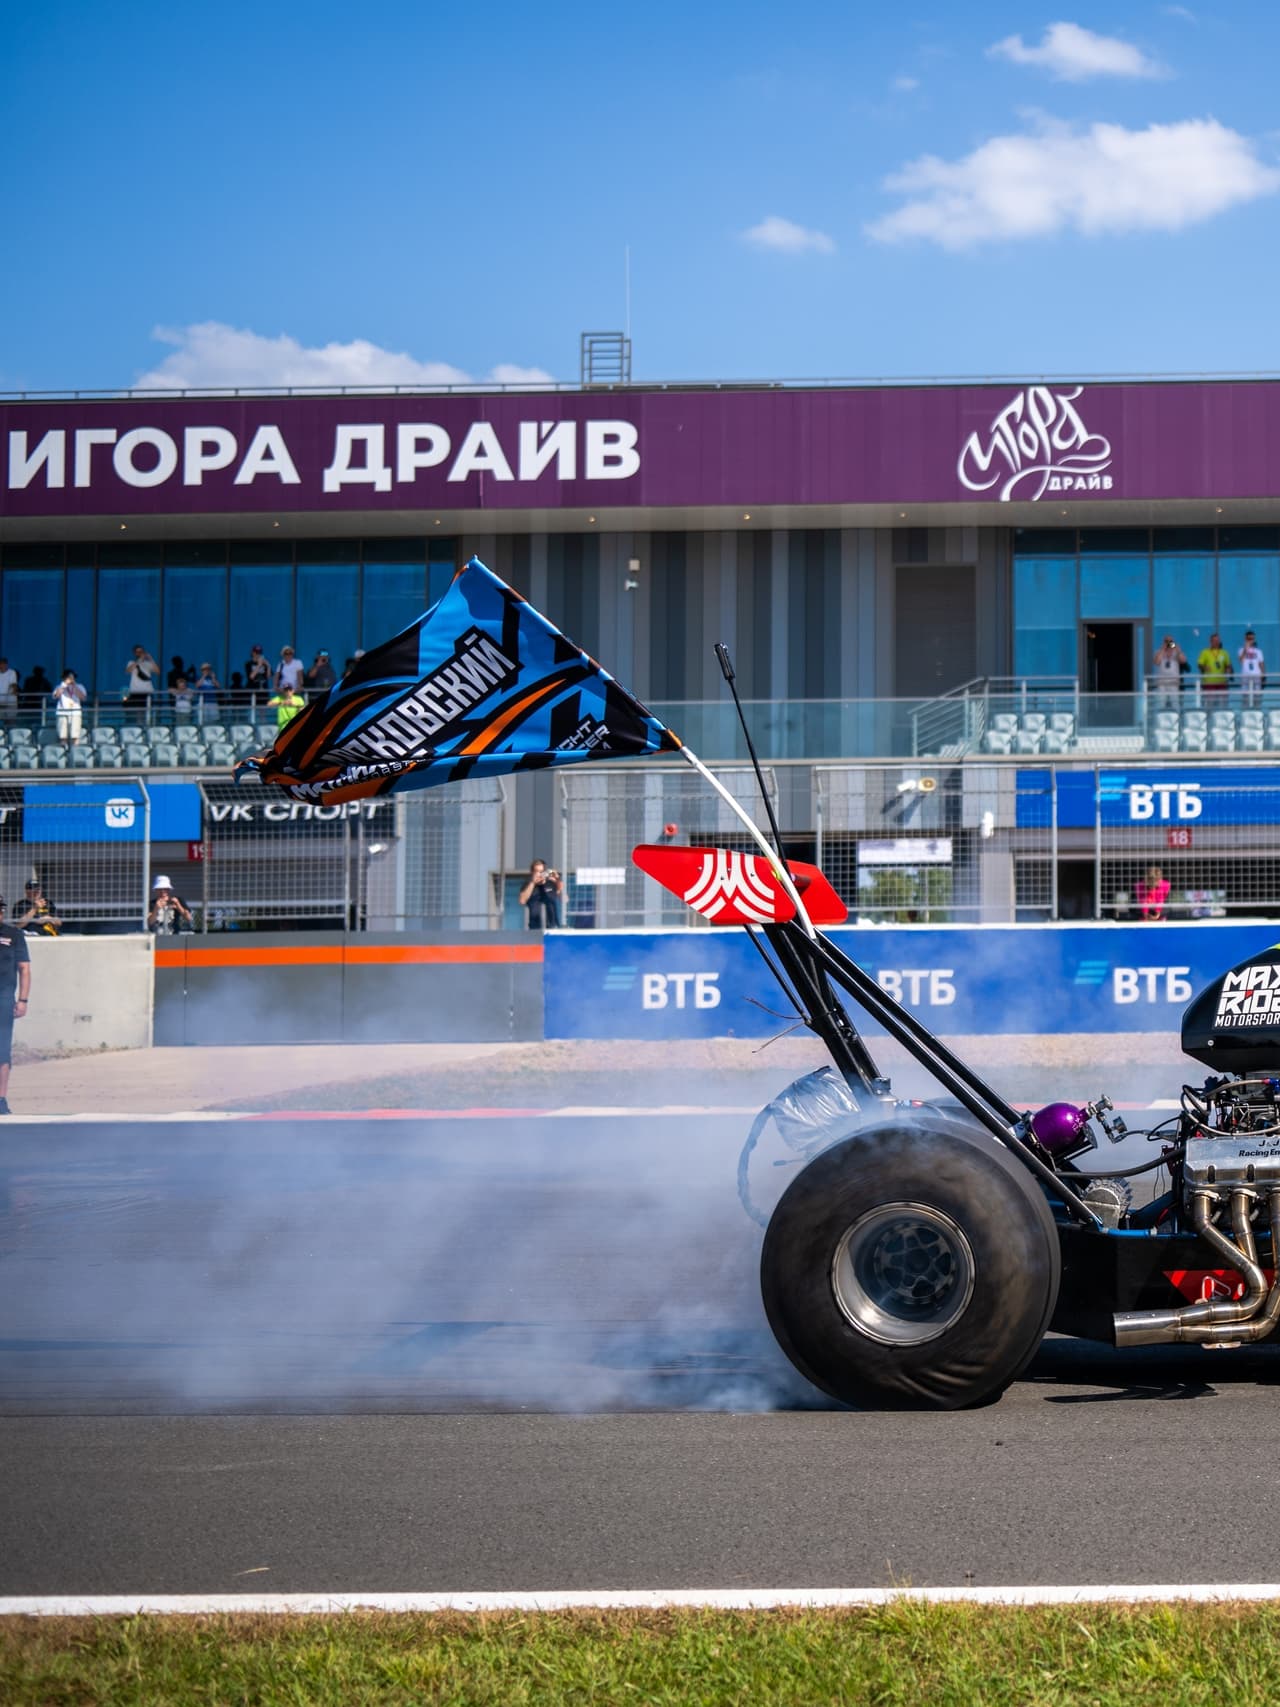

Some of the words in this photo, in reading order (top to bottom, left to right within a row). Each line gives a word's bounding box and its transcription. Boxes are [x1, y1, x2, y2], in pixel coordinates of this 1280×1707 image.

[8, 425, 301, 490] ИГОРА
[322, 420, 641, 492] ДРАЙВ
[1047, 473, 1114, 491] ДРАЙВ
[112, 807, 129, 818] VK
[210, 804, 254, 821] VK
[263, 801, 386, 821] СПОРТ
[1129, 784, 1202, 820] ВТБ
[1171, 832, 1190, 845] 18
[642, 972, 721, 1010] ВТБ
[878, 969, 956, 1006] ВТБ
[1113, 966, 1193, 1003] ВТБ
[1239, 1149, 1269, 1158] Racing
